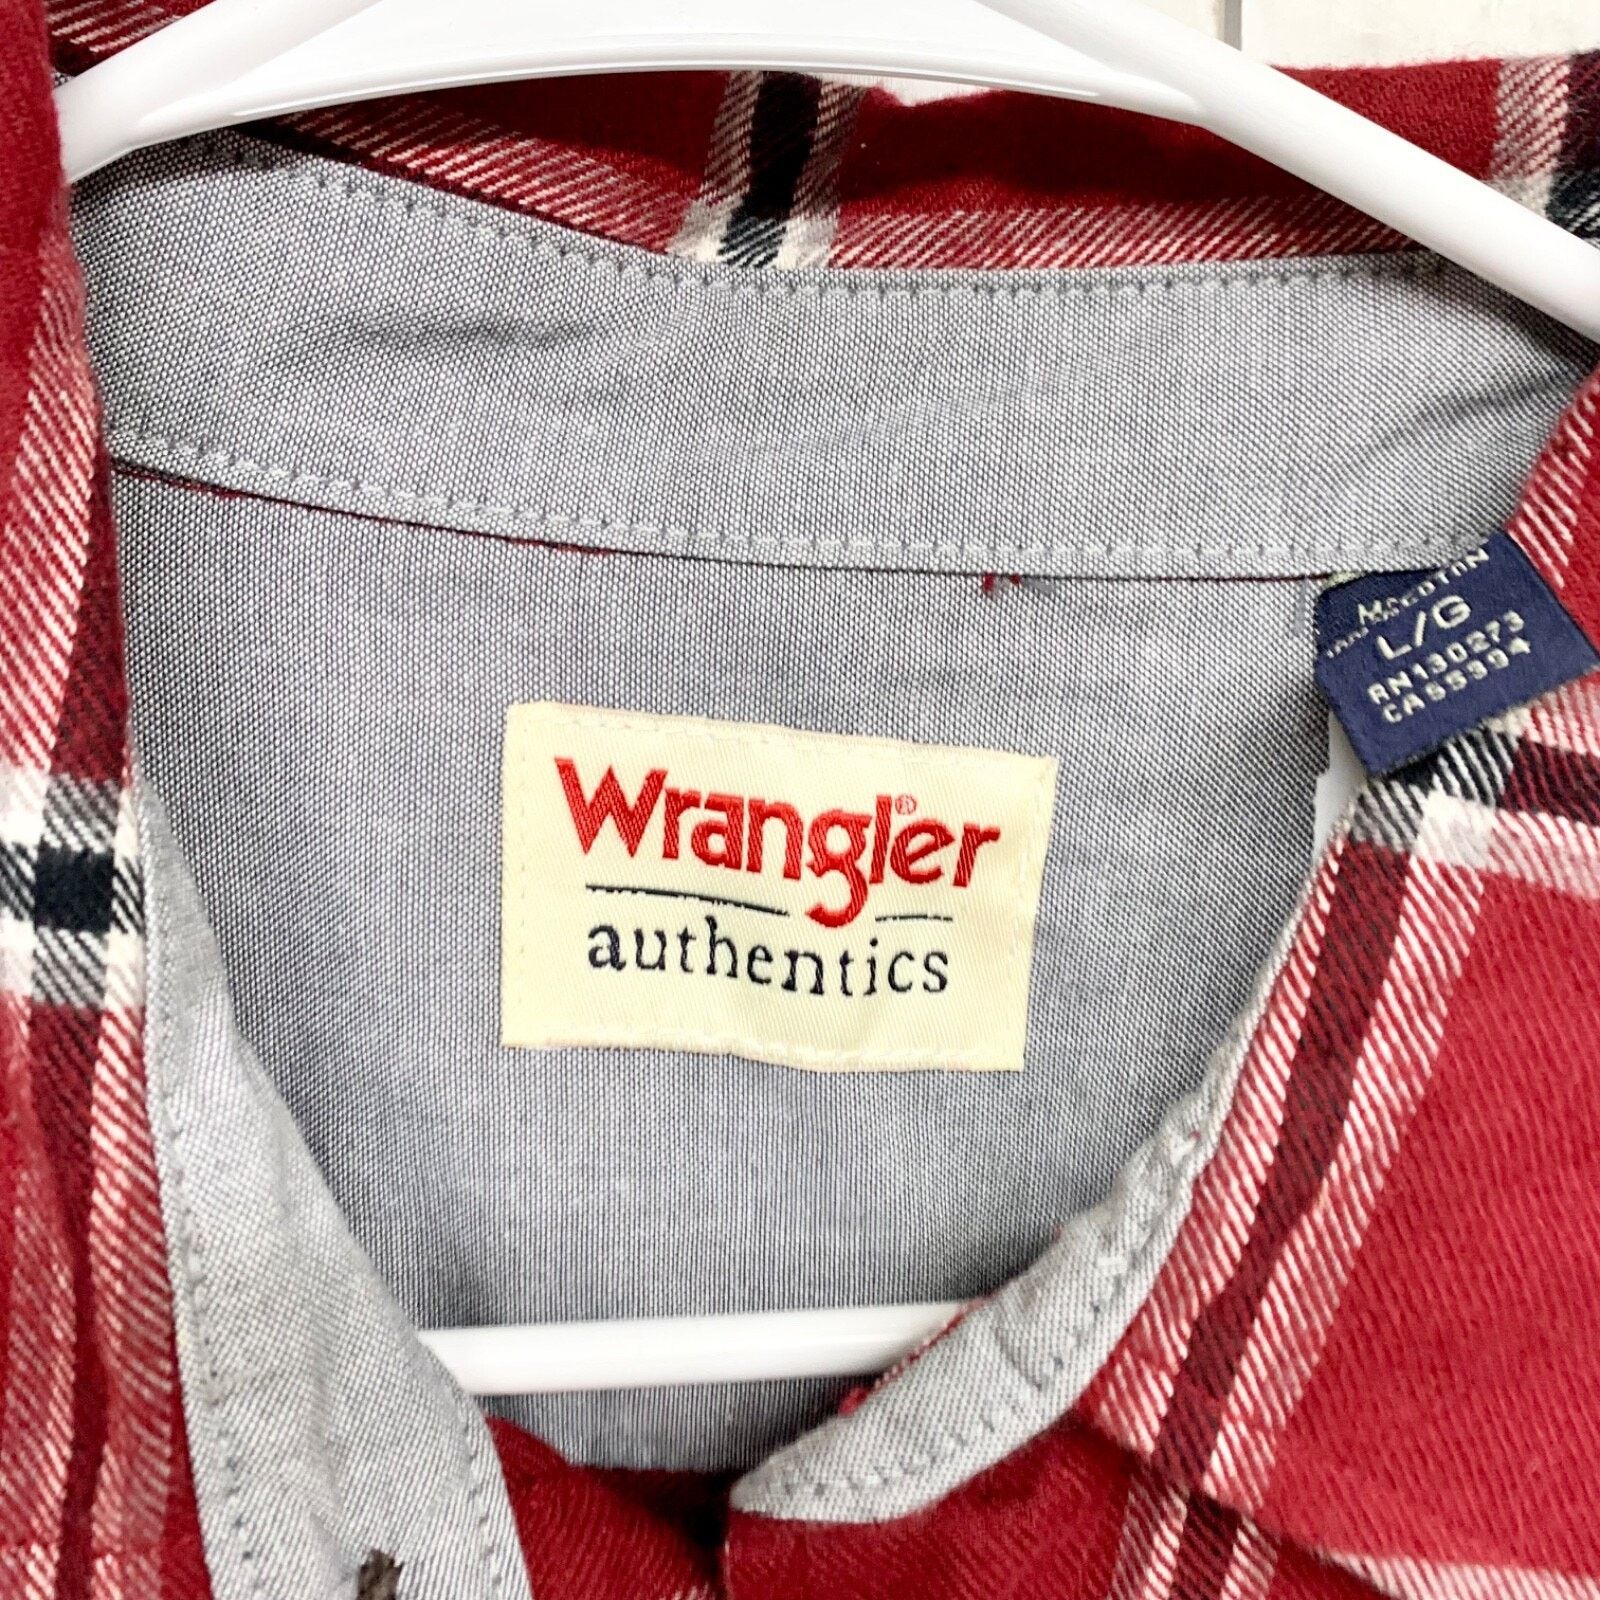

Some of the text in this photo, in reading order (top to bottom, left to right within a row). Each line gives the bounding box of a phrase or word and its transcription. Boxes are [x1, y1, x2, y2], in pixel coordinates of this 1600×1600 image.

[1367, 610, 1525, 705] RN130273
[1376, 595, 1472, 660] L/G
[554, 756, 1001, 928] Wrangler
[586, 914, 950, 997] authentics
